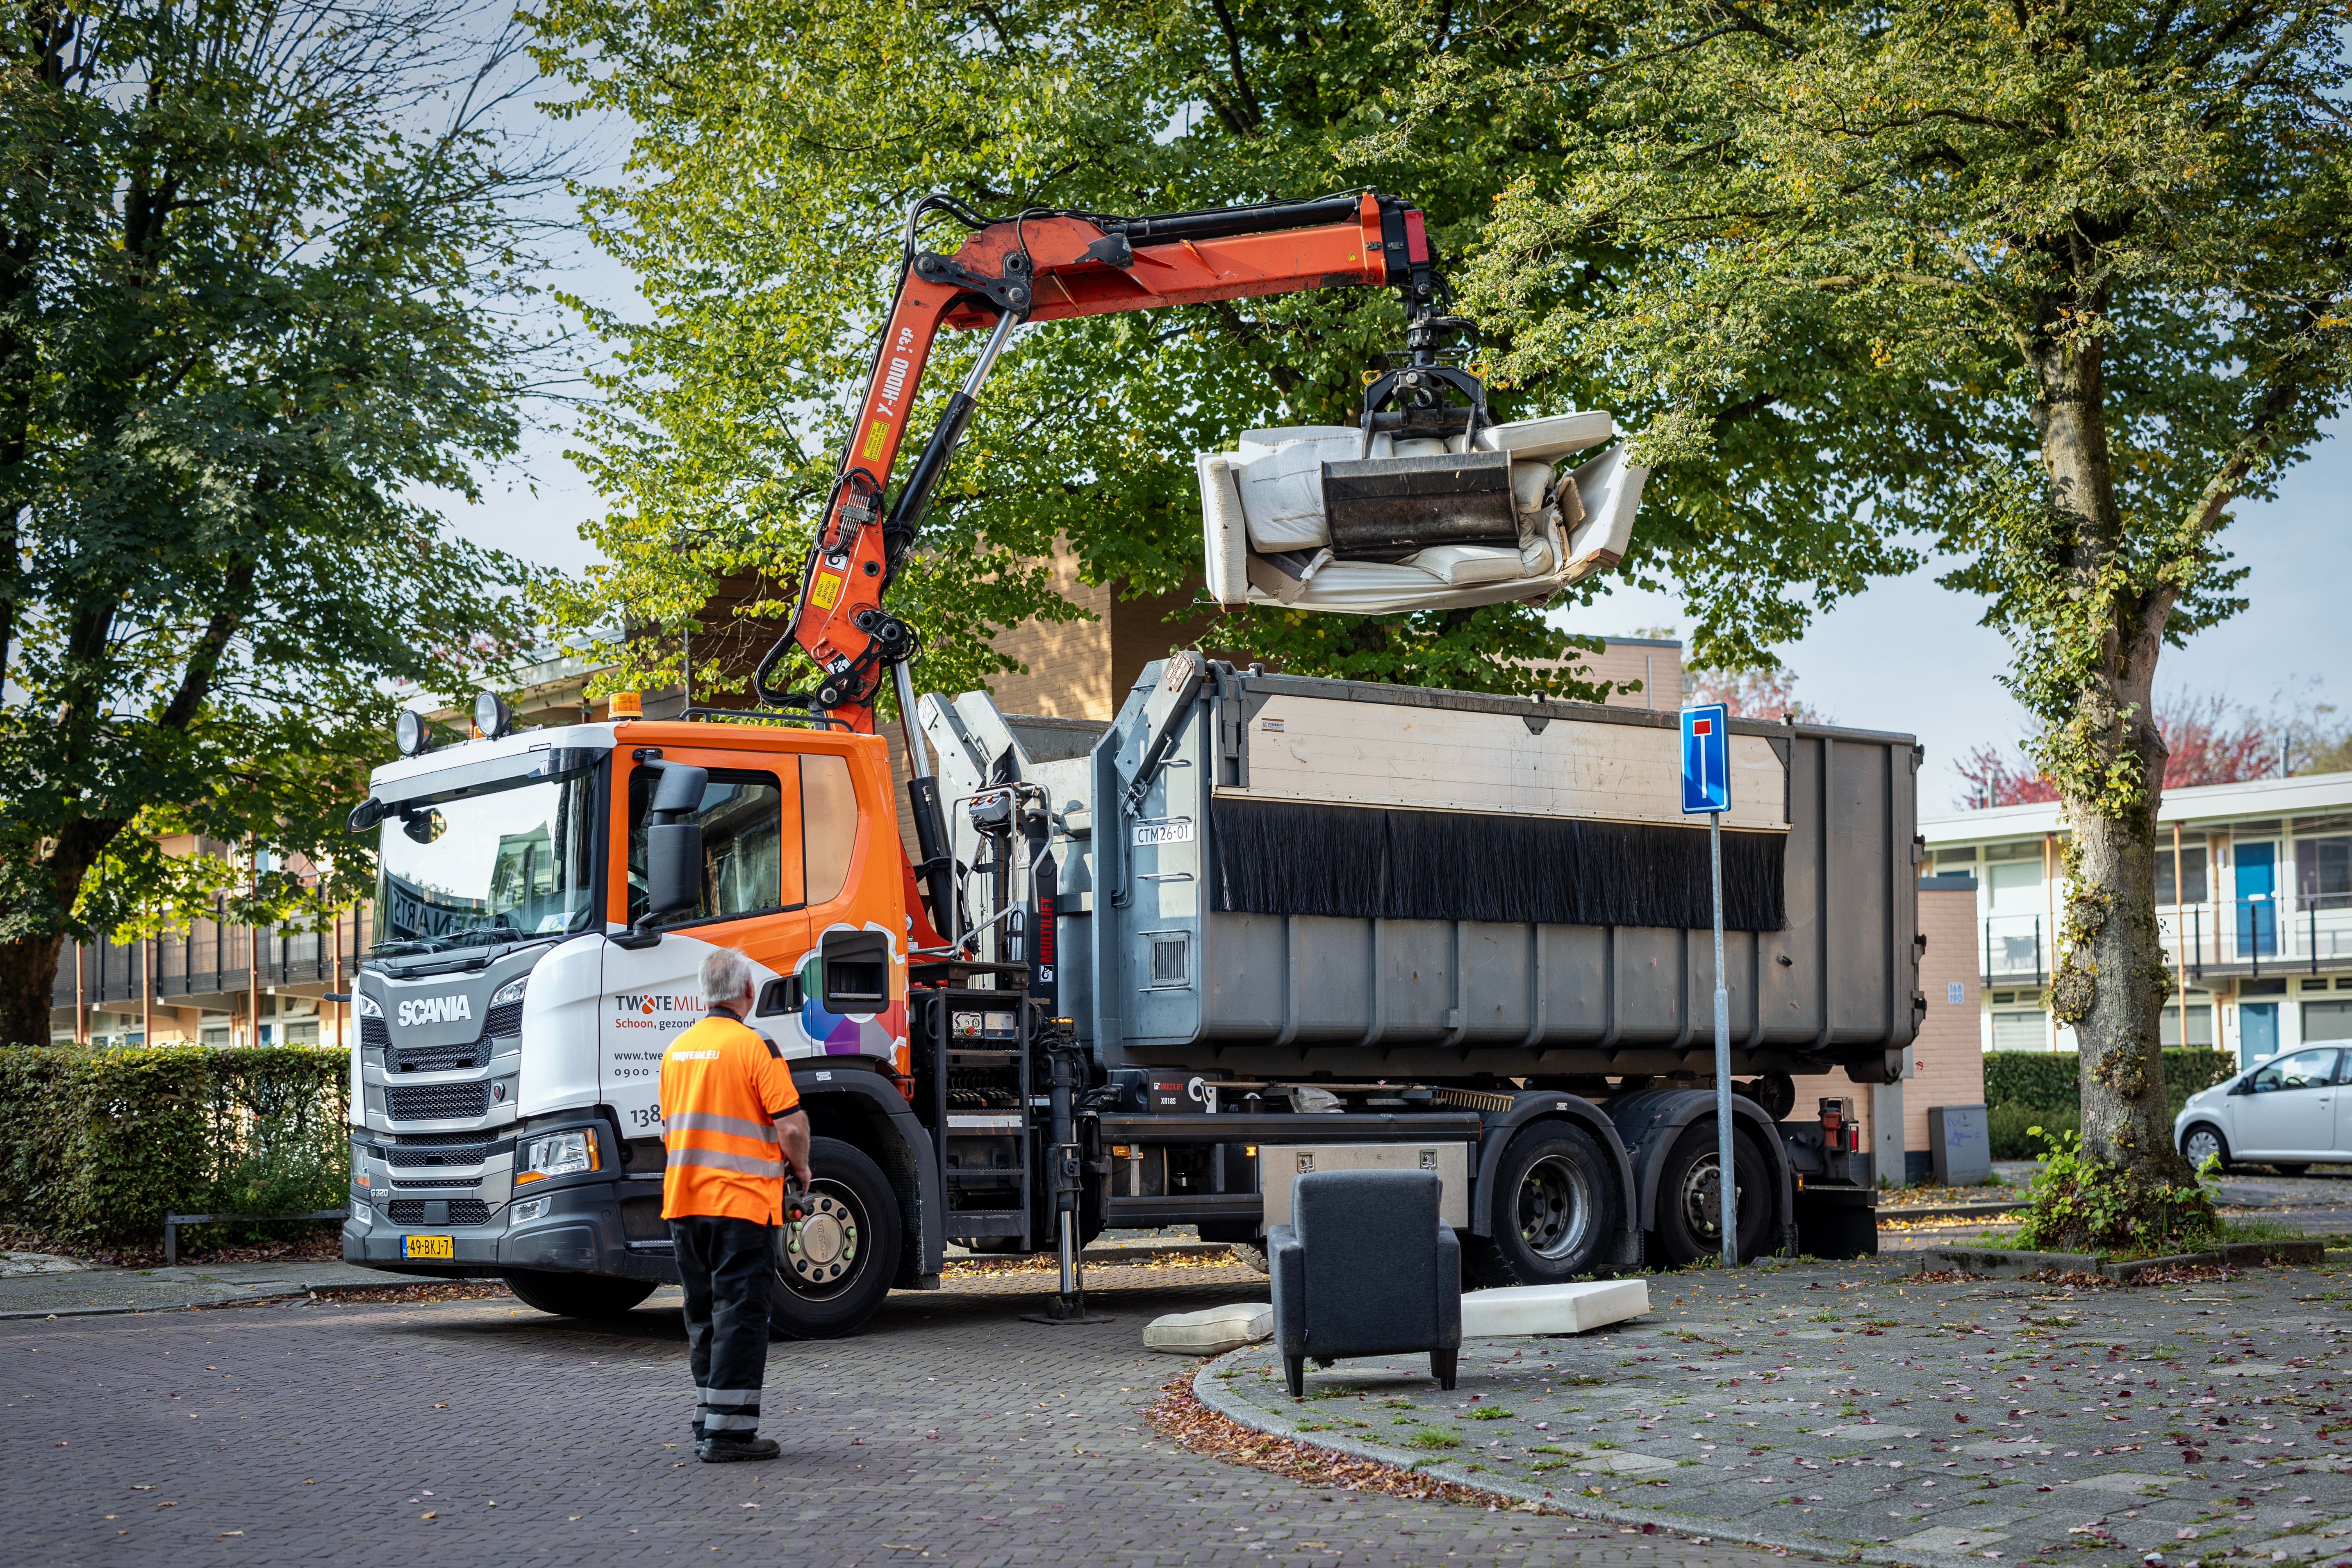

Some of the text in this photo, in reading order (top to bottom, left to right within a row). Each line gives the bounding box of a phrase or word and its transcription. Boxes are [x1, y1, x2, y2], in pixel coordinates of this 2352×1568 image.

[876, 357, 909, 417] X-HIDUO
[821, 580, 832, 601] GRAFISCH
[827, 582, 837, 603] BESTUURD
[1040, 897, 1053, 963] MULTILIFT
[1950, 994, 1963, 1004] 190
[398, 995, 472, 1027] SCANIA
[616, 1018, 656, 1029] Schoon,
[614, 1069, 649, 1078] 0900
[630, 1104, 661, 1127] 138
[371, 1189, 389, 1197] G320
[410, 1238, 449, 1255] 49-BKJ-7
[817, 1220, 828, 1260] SCANIA
